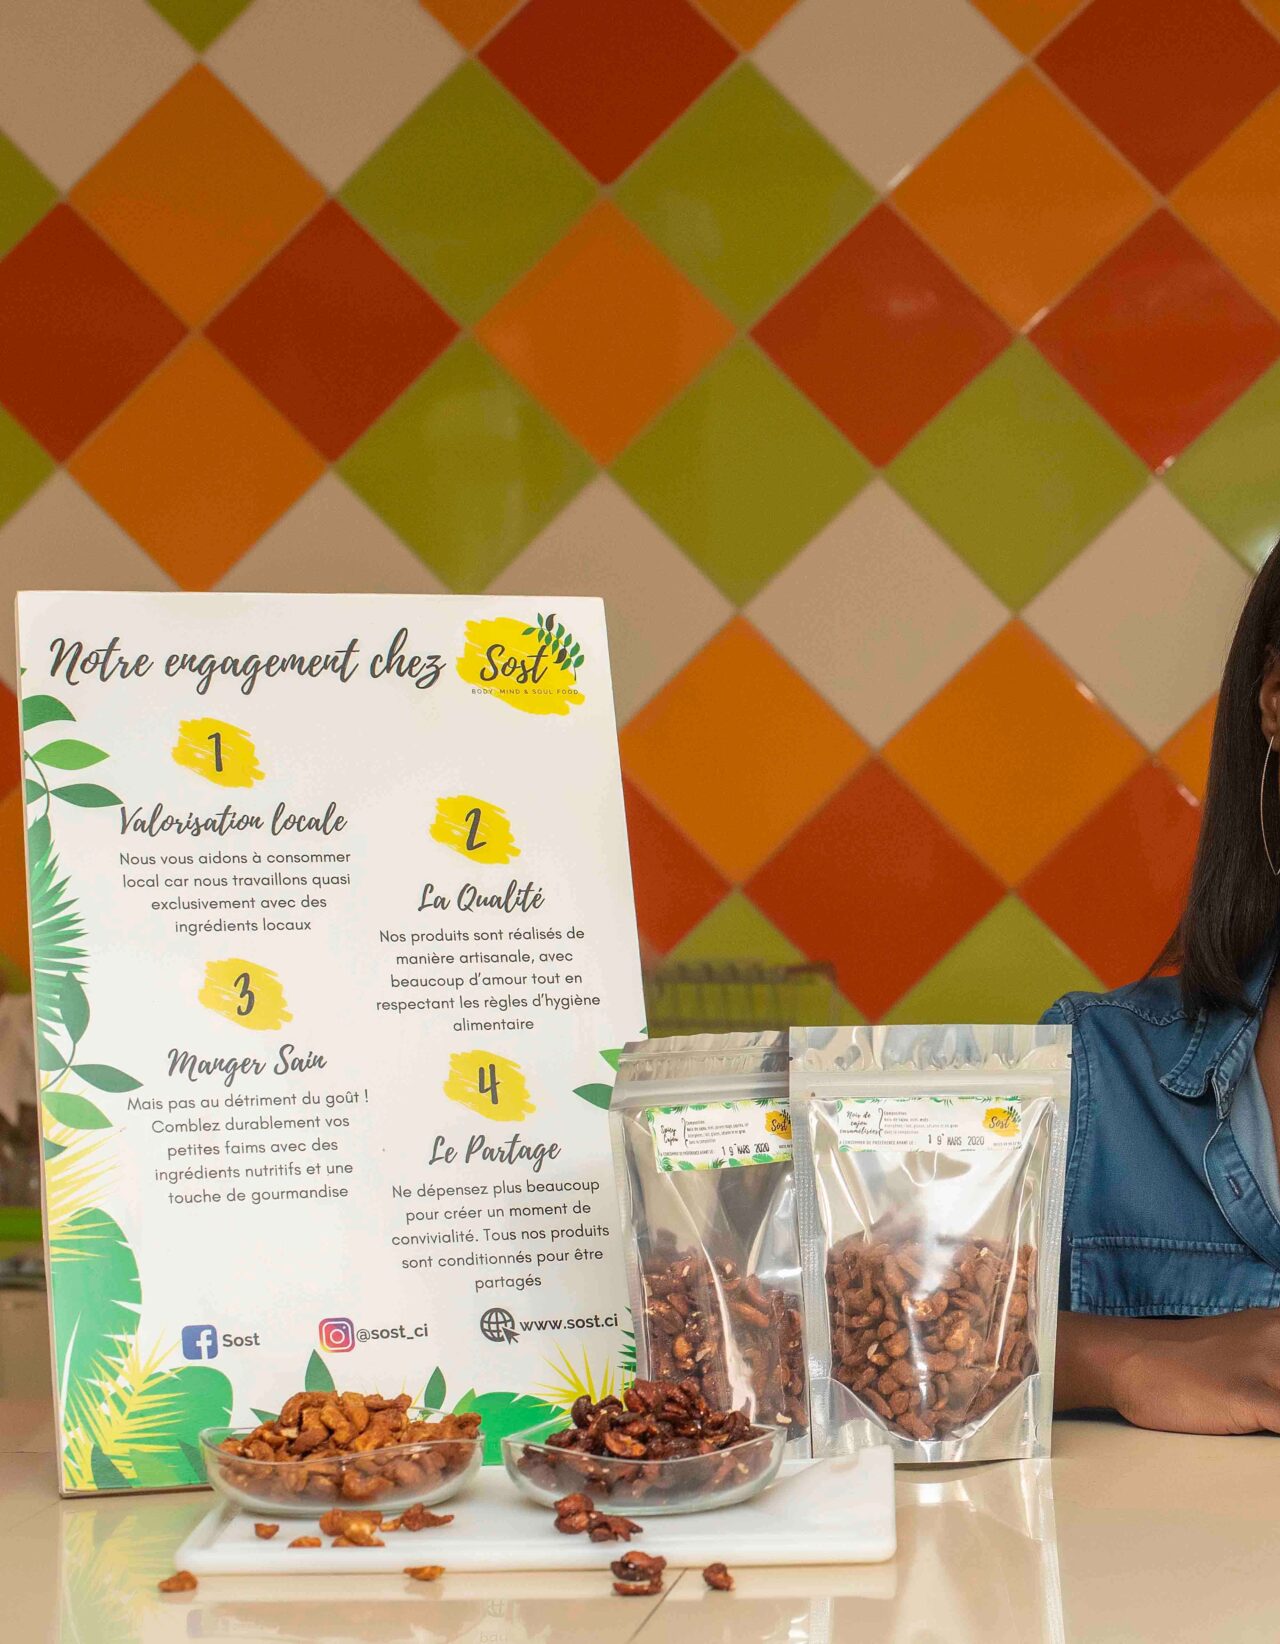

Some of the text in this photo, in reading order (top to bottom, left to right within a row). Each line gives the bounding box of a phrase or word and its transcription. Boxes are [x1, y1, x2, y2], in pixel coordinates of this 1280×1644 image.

[49, 627, 447, 696] Notre engagement chez
[480, 643, 549, 684] Sost
[499, 688, 520, 696] MIND
[523, 688, 529, 696] &
[532, 688, 553, 696] SOUL
[556, 688, 579, 696] FOOD
[207, 732, 223, 772] 1
[120, 801, 348, 838] Valorisation locale
[464, 808, 487, 852] 2
[119, 850, 351, 866] Nous vous aidons à consommer
[122, 871, 351, 889] local car nous travaillons quasi
[151, 893, 327, 911] exclusivement avec des
[417, 878, 546, 914] La Qualité
[175, 917, 312, 937] ingrédients locaux
[379, 925, 585, 946] Nos produits sont réalisés de
[396, 948, 574, 965] manière artisanale, avec
[390, 971, 583, 991] beaucoup d'amour tout en
[233, 972, 255, 1016] 3
[376, 992, 601, 1014] respectant les règles d'hygiène
[453, 1017, 535, 1032] alimentaire
[167, 1043, 328, 1088] Manger Sain
[478, 1063, 500, 1105] 4
[127, 1097, 164, 1111] Mais
[168, 1099, 196, 1114] pas
[200, 1098, 220, 1109] au
[224, 1092, 297, 1108] détriment
[301, 1090, 321, 1105] du
[325, 1090, 360, 1109] goût
[151, 1115, 350, 1134] Comblez durablement vos
[771, 1119, 789, 1132] Sost
[863, 1111, 871, 1119] de
[988, 1115, 1011, 1129] Sost
[167, 1136, 339, 1161] petites faims avec des
[754, 1142, 770, 1154] 2020
[946, 1136, 962, 1146] MARS
[967, 1135, 985, 1146] 2020
[428, 1133, 562, 1174] Le Partage
[155, 1161, 354, 1185] ingrédients nutritifs et une
[167, 1183, 349, 1205] touche de gourmandise
[392, 1178, 600, 1201] Ne dépensez plus beaucoup
[405, 1199, 592, 1226] pour créer un moment de
[391, 1223, 610, 1246] convivialité. Tous nos produits
[401, 1248, 604, 1269] sont conditionnés pour être
[474, 1273, 542, 1293] partagés
[519, 1312, 619, 1332] www.sost.ci
[222, 1332, 261, 1348] Sost
[355, 1323, 429, 1343] @sost_ci
